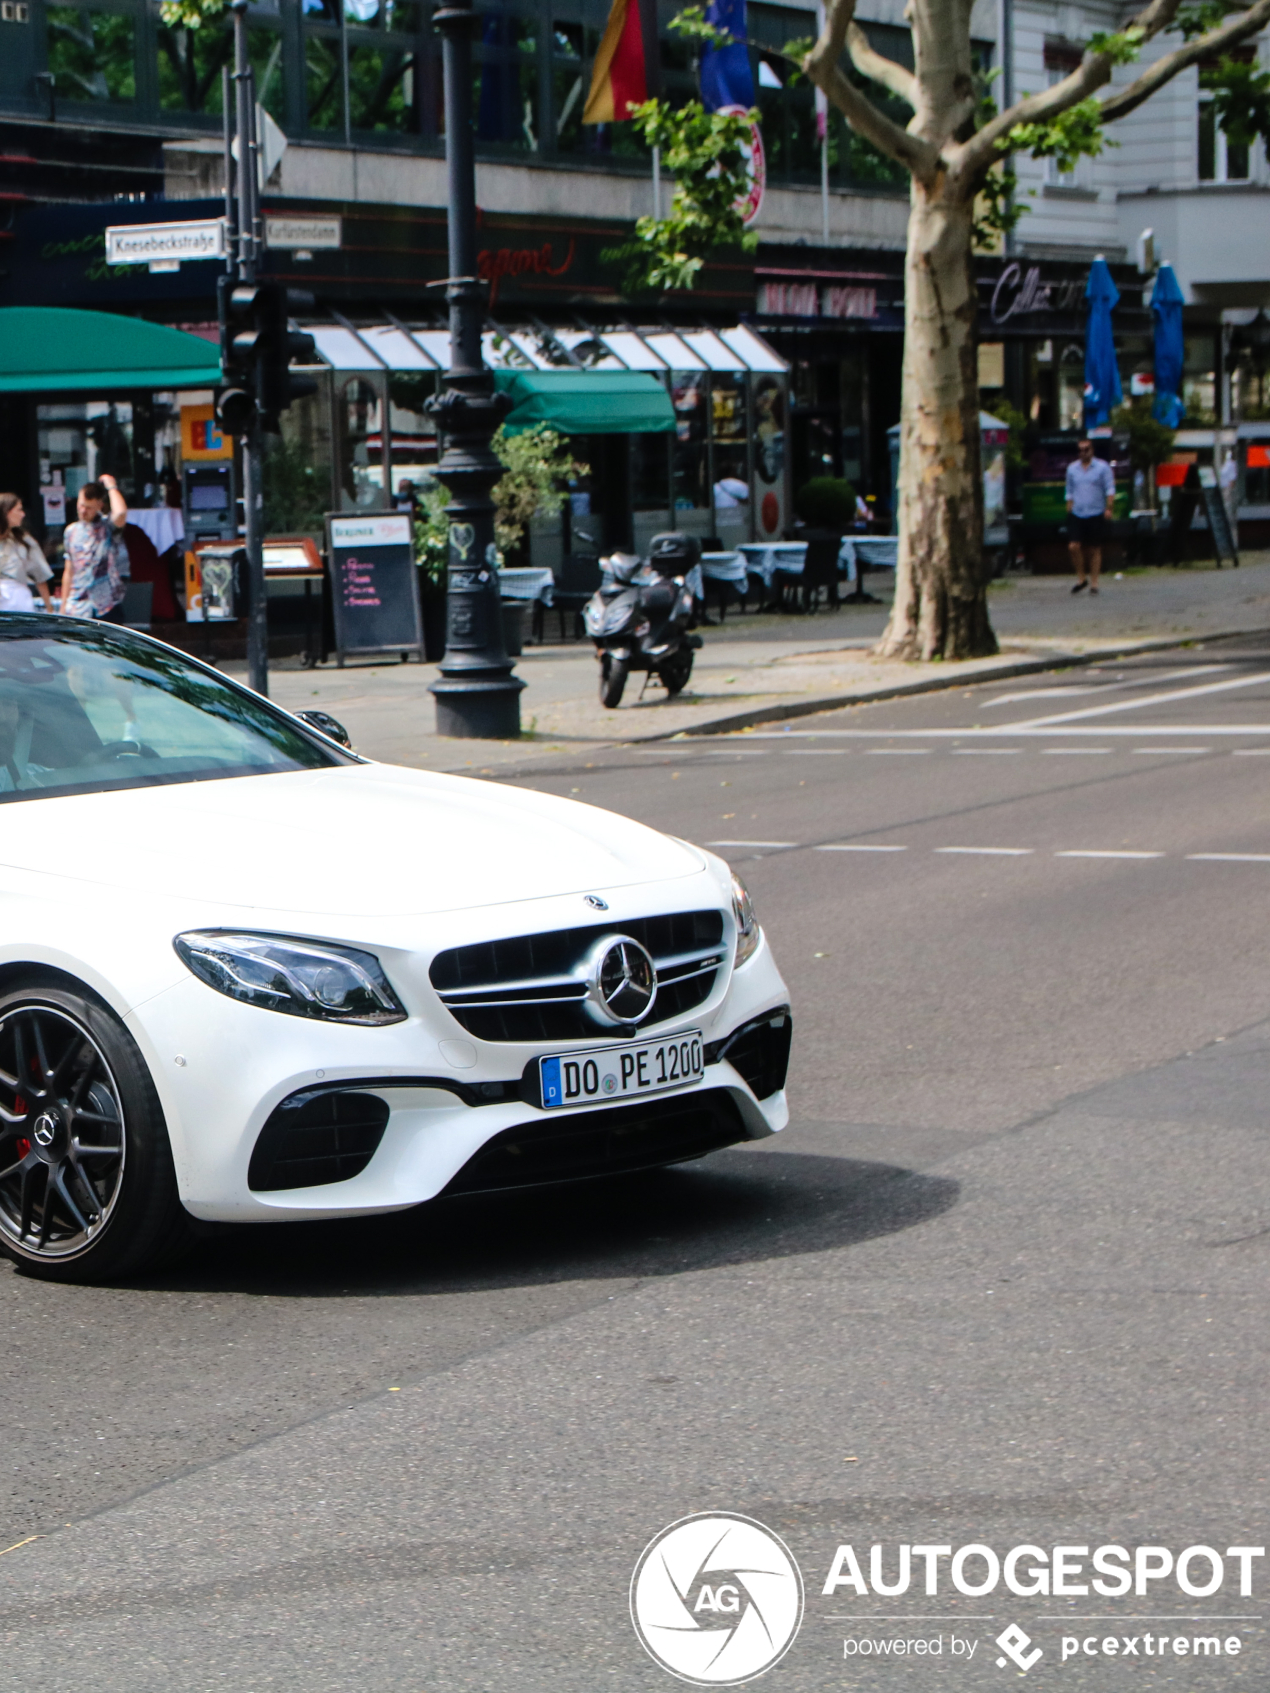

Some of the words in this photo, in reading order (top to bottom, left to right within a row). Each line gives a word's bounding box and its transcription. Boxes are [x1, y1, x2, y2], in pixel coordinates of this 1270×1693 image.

[115, 232, 215, 253] Knesebeckstraße
[563, 1059, 598, 1098] DO
[620, 1051, 650, 1089] PE
[656, 1039, 701, 1083] 1200
[549, 1087, 556, 1097] D
